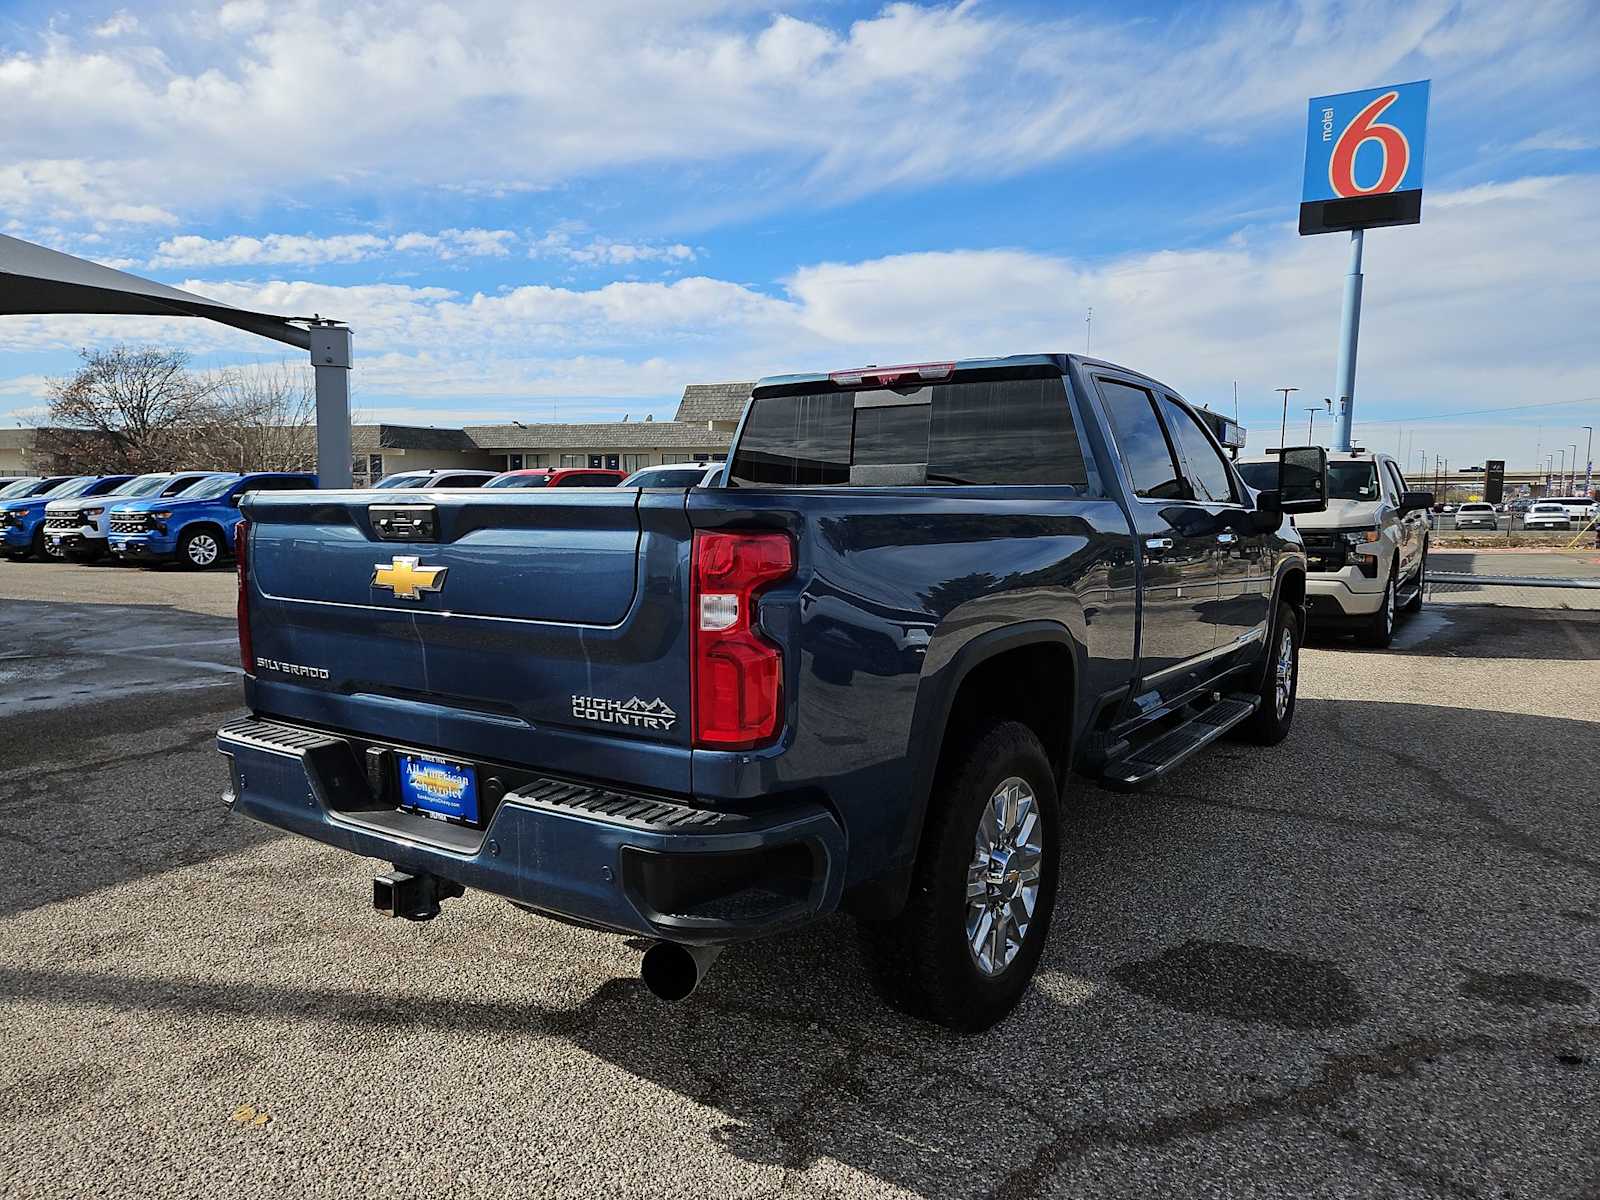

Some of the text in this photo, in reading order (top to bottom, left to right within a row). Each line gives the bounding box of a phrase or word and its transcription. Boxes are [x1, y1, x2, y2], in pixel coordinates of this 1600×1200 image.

[1322, 91, 1410, 199] motel 6
[256, 657, 330, 679] SILVERADO
[571, 695, 621, 711] HIGH
[572, 706, 676, 730] COUNTRY
